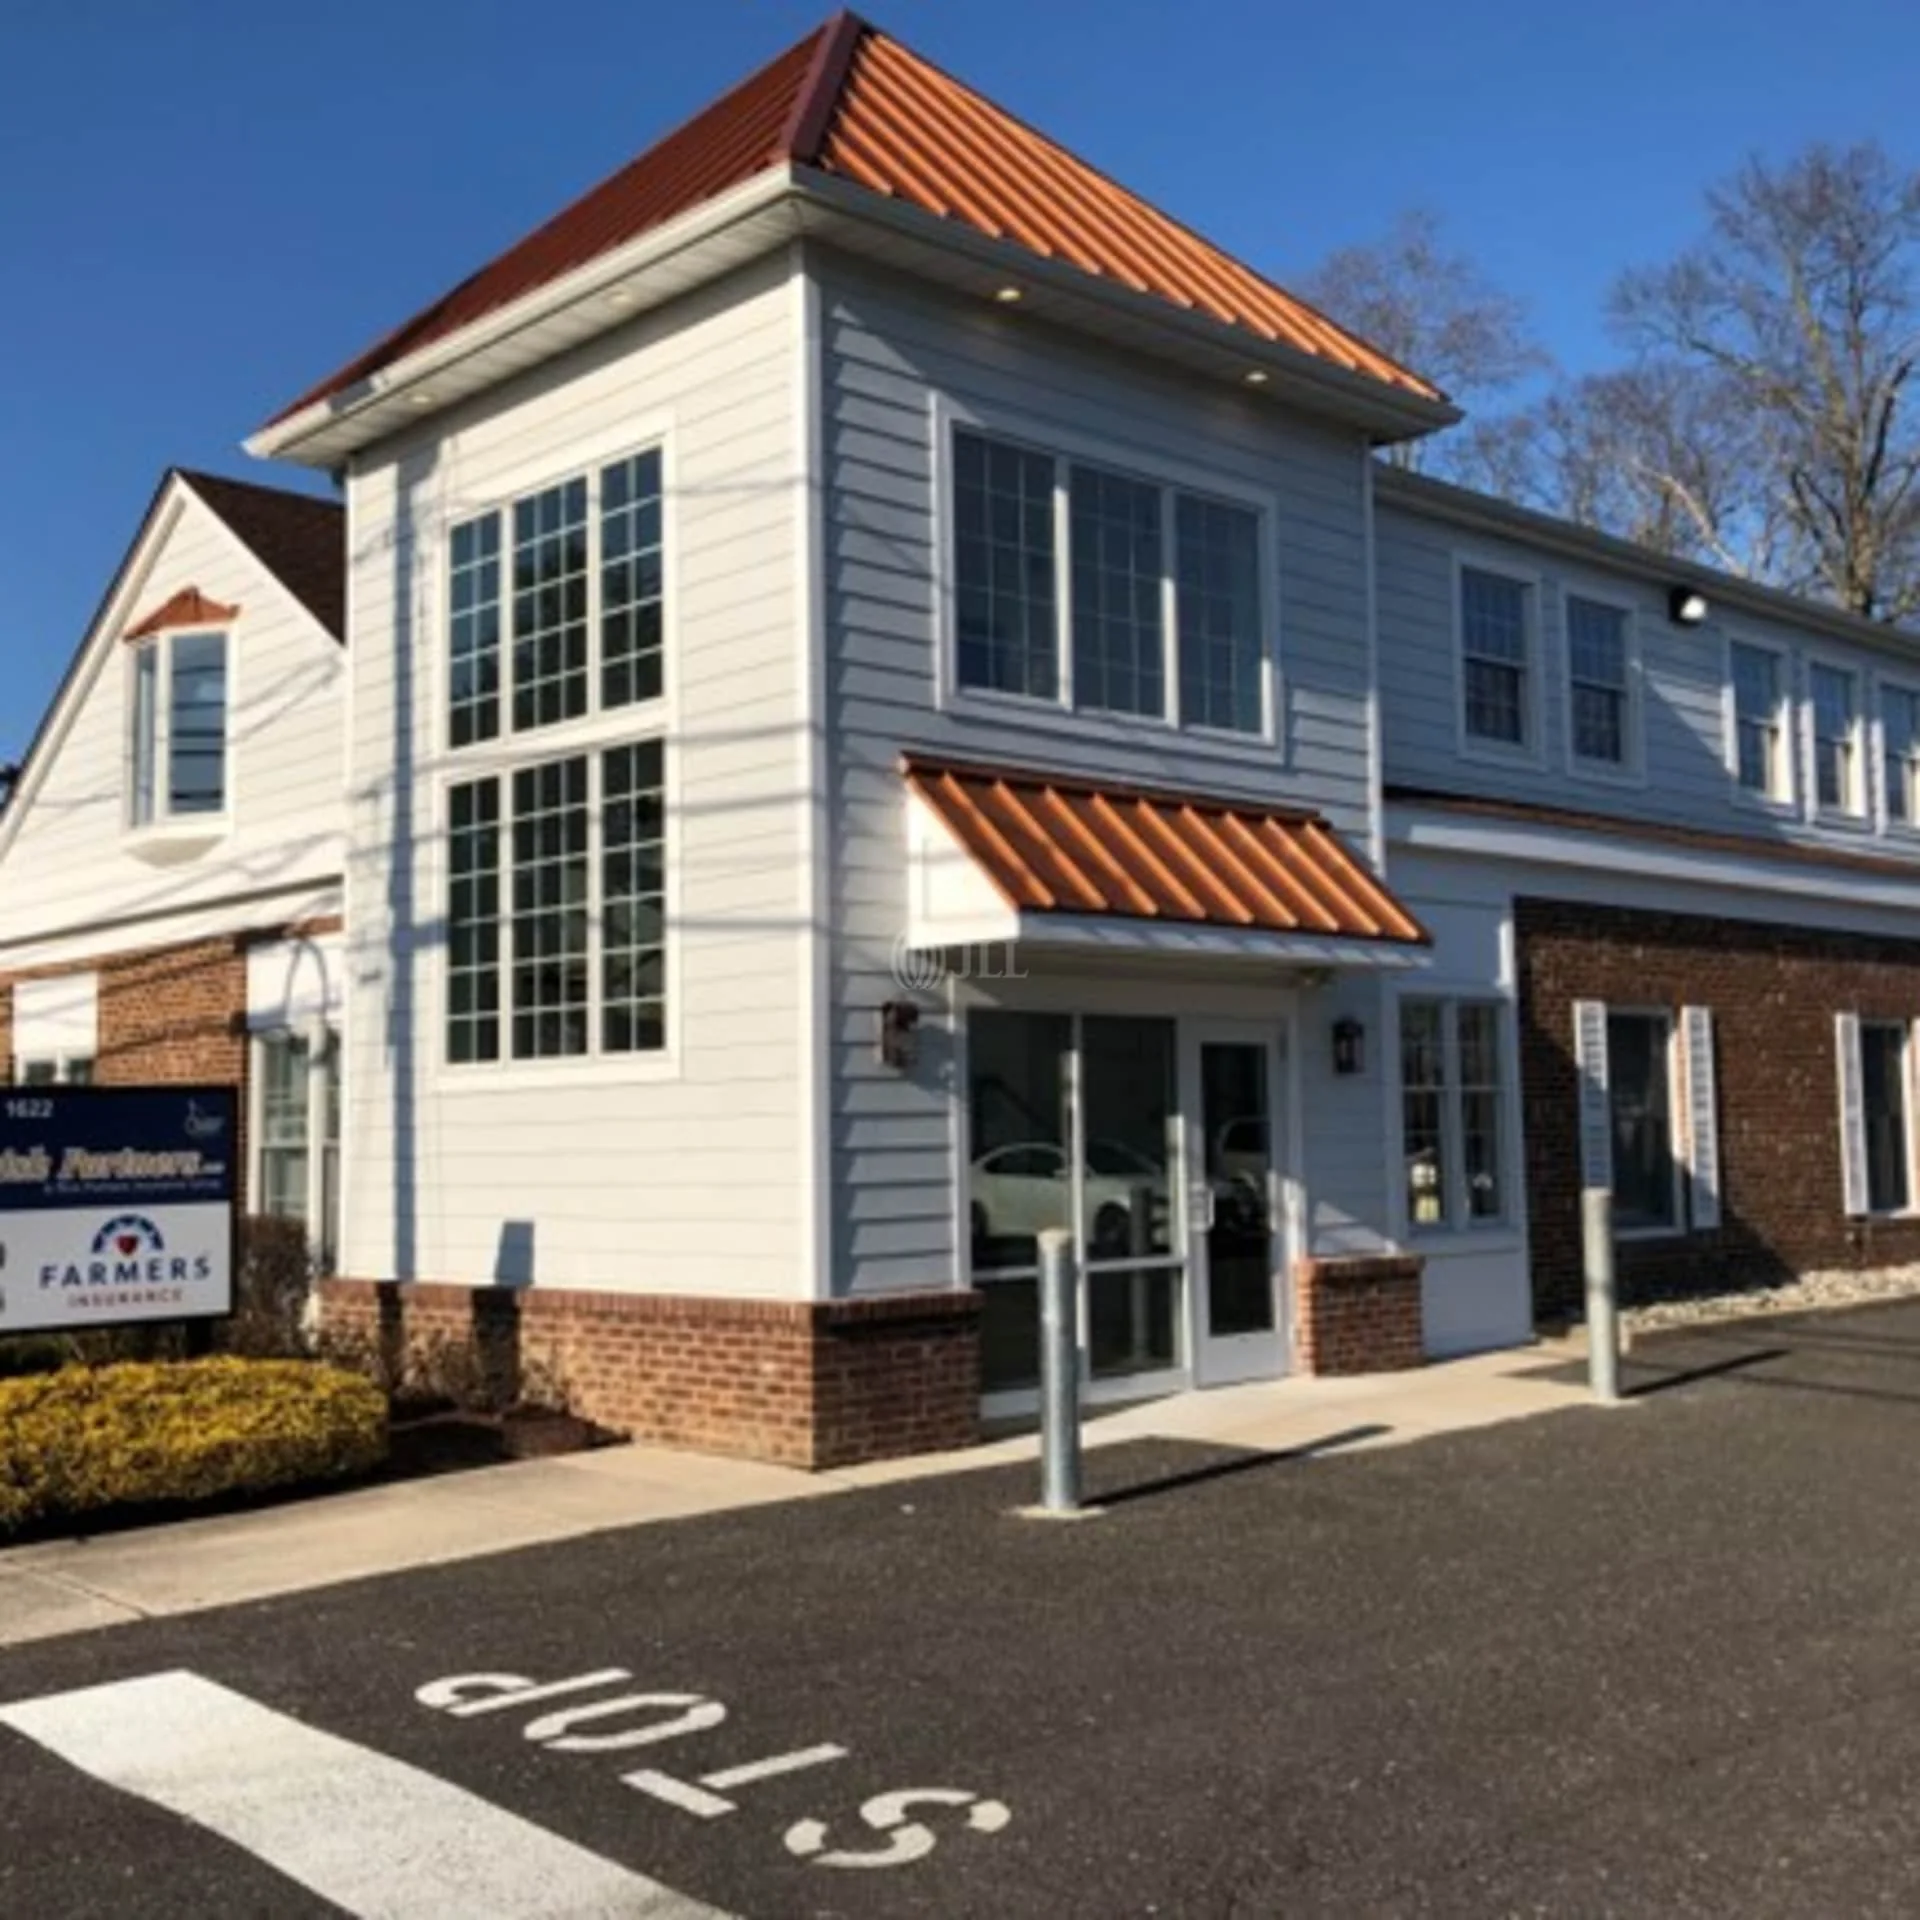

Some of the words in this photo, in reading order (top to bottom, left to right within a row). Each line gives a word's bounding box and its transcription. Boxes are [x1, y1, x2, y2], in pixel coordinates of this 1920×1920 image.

[5, 1098, 54, 1118] 1622
[39, 1257, 211, 1288] FARMERS
[415, 1668, 1011, 1868] STOP
